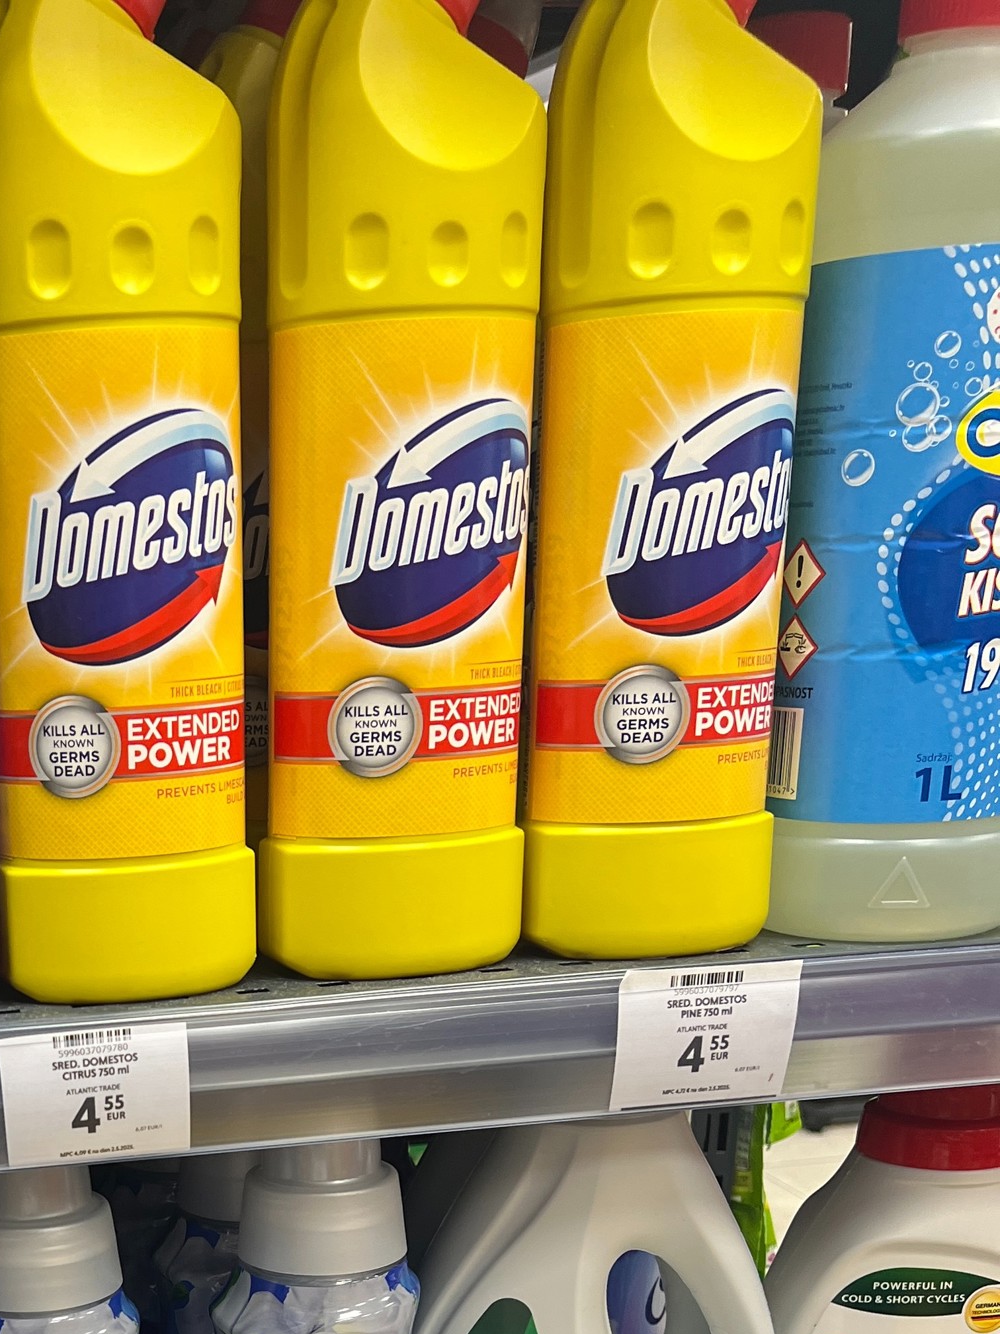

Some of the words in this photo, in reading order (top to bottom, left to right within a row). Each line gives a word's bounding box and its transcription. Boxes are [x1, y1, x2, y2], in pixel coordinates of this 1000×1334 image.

[601, 449, 794, 577] Domesto
[21, 471, 238, 603] Domestos
[612, 693, 647, 705] KILLS
[652, 693, 676, 704] ALL
[697, 681, 775, 709] EXTENDE
[344, 705, 381, 718] KILLS
[384, 705, 408, 717] ALL
[623, 707, 665, 716] KNOWN
[43, 725, 76, 737] KILLS
[81, 724, 105, 736] ALL
[127, 709, 240, 742] EXTENDED
[355, 720, 397, 728] KNOWN
[617, 718, 669, 730] GERMS
[350, 731, 402, 743] GERMS
[428, 718, 515, 750] POWER
[621, 732, 663, 743] DEAD
[54, 739, 94, 748] KNOWN
[49, 751, 100, 763] GERMS
[128, 736, 232, 770] POWER
[354, 744, 397, 757] DEAD
[55, 765, 95, 777] DEAD
[157, 783, 216, 799] PREVENTS
[667, 1000, 693, 1009] SRED.
[695, 995, 747, 1007] DOMESTOS
[681, 1009, 702, 1019] PINE
[704, 1008, 719, 1017] 750
[677, 1035, 705, 1073] 4
[710, 1034, 729, 1051] 55
[710, 1052, 728, 1061] EUR
[52, 1060, 81, 1071] SRED.
[82, 1053, 138, 1068] DOMESTOS
[62, 1069, 97, 1081] CITRUS
[98, 1067, 115, 1077] 750
[71, 1096, 100, 1134] 4
[104, 1094, 124, 1111] 55
[106, 1112, 126, 1121] EUR
[873, 1281, 937, 1290] POWERFUL
[940, 1281, 953, 1290] IN
[842, 1294, 872, 1303] COLD
[886, 1295, 924, 1304] SHORT
[927, 1294, 966, 1303] CYCLES
